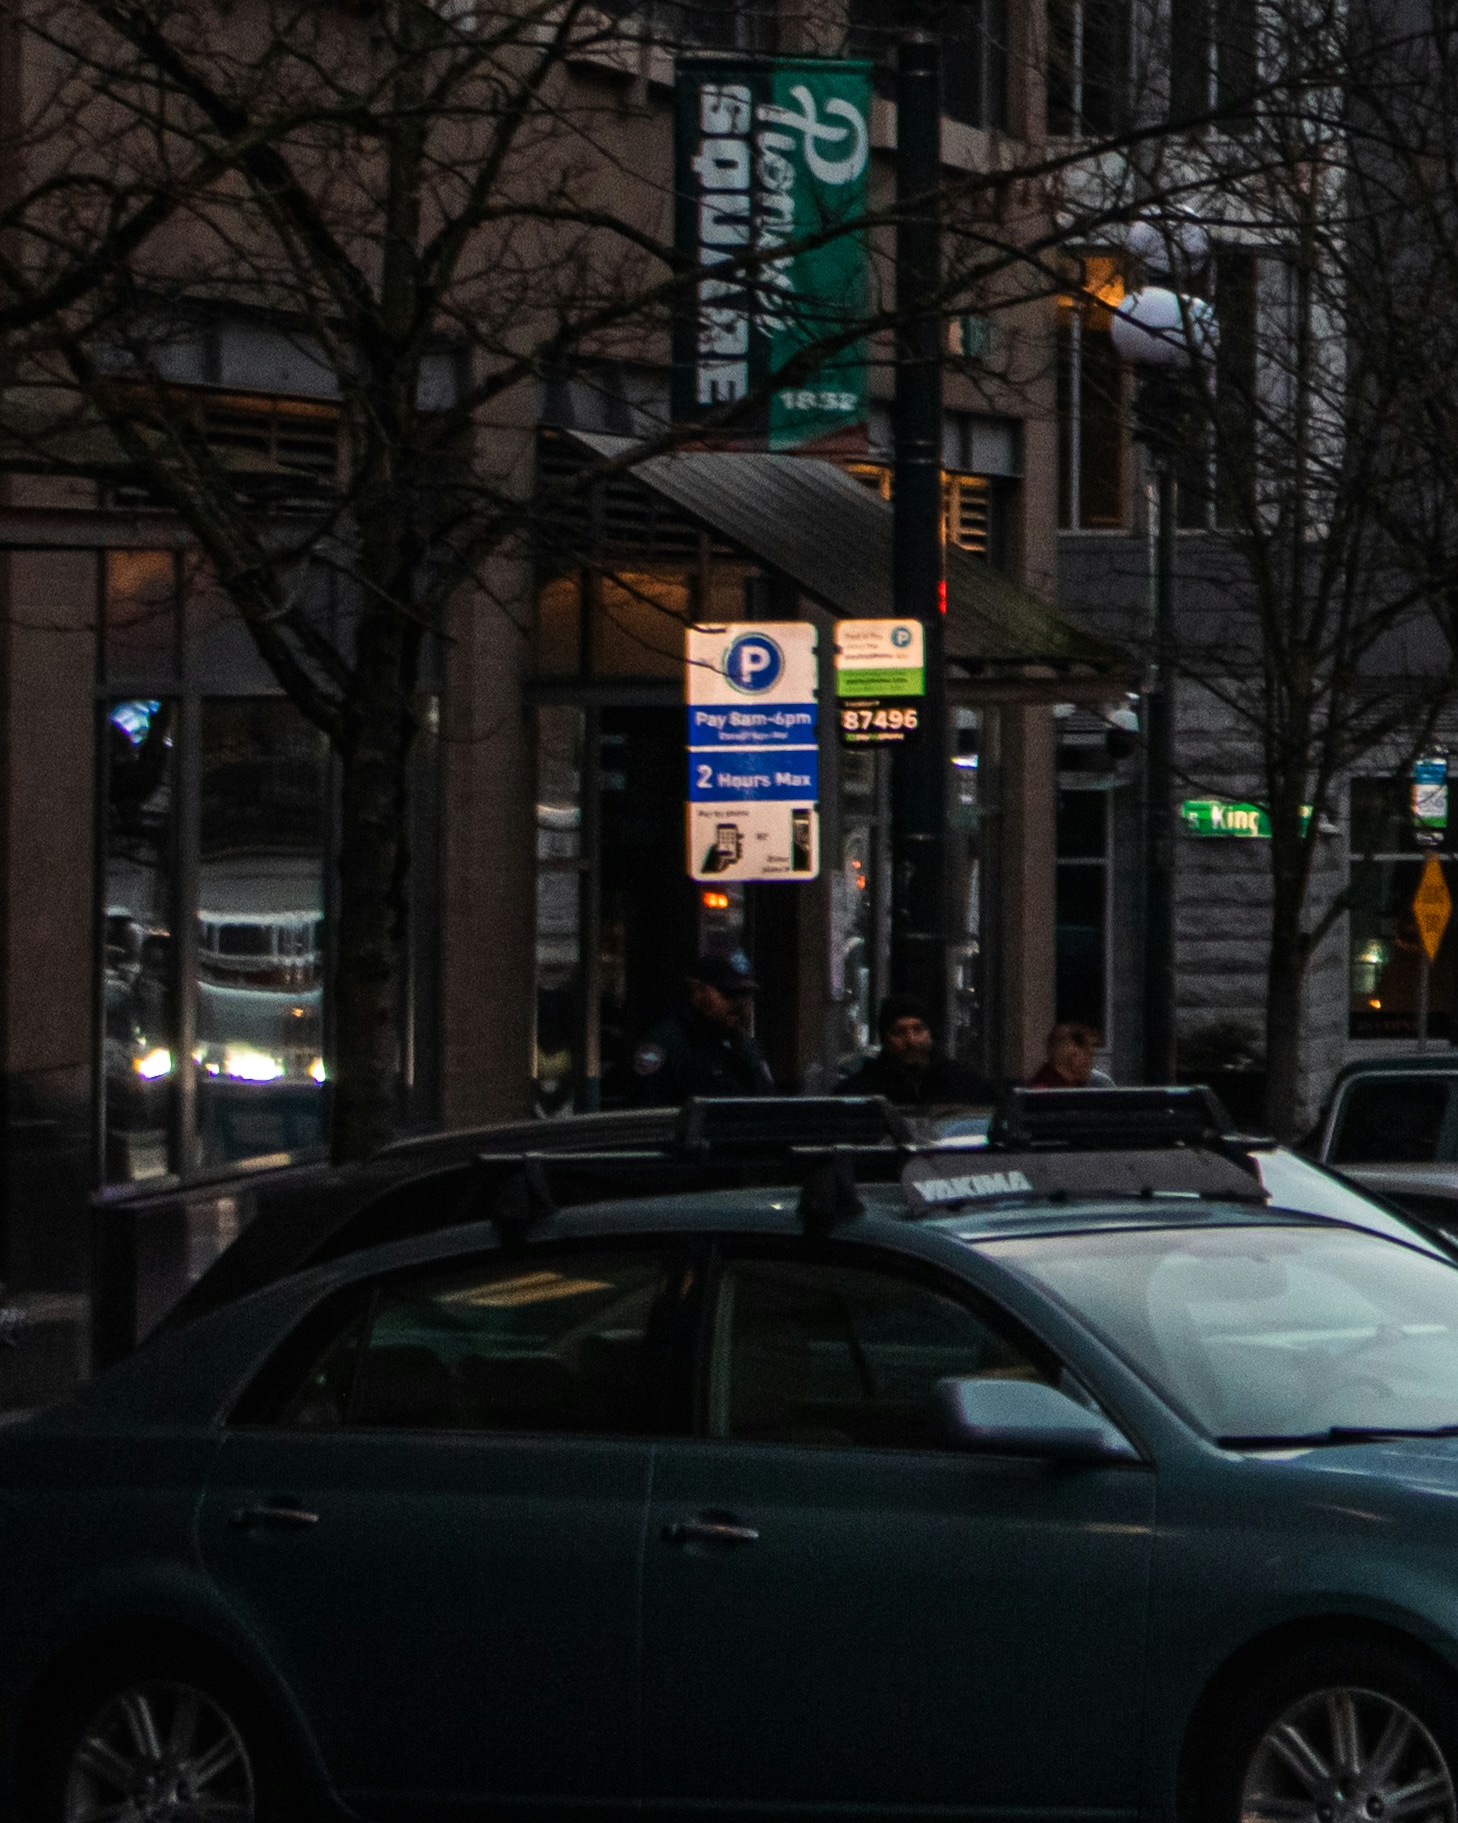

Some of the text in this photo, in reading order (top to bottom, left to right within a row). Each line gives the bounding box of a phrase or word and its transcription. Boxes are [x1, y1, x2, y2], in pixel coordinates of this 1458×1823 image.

[694, 711, 725, 729] Pay
[841, 709, 918, 731] 87496
[696, 765, 811, 788] 2 Hours Max
[1211, 805, 1260, 837] King
[913, 1170, 1034, 1203] YAKIMA
